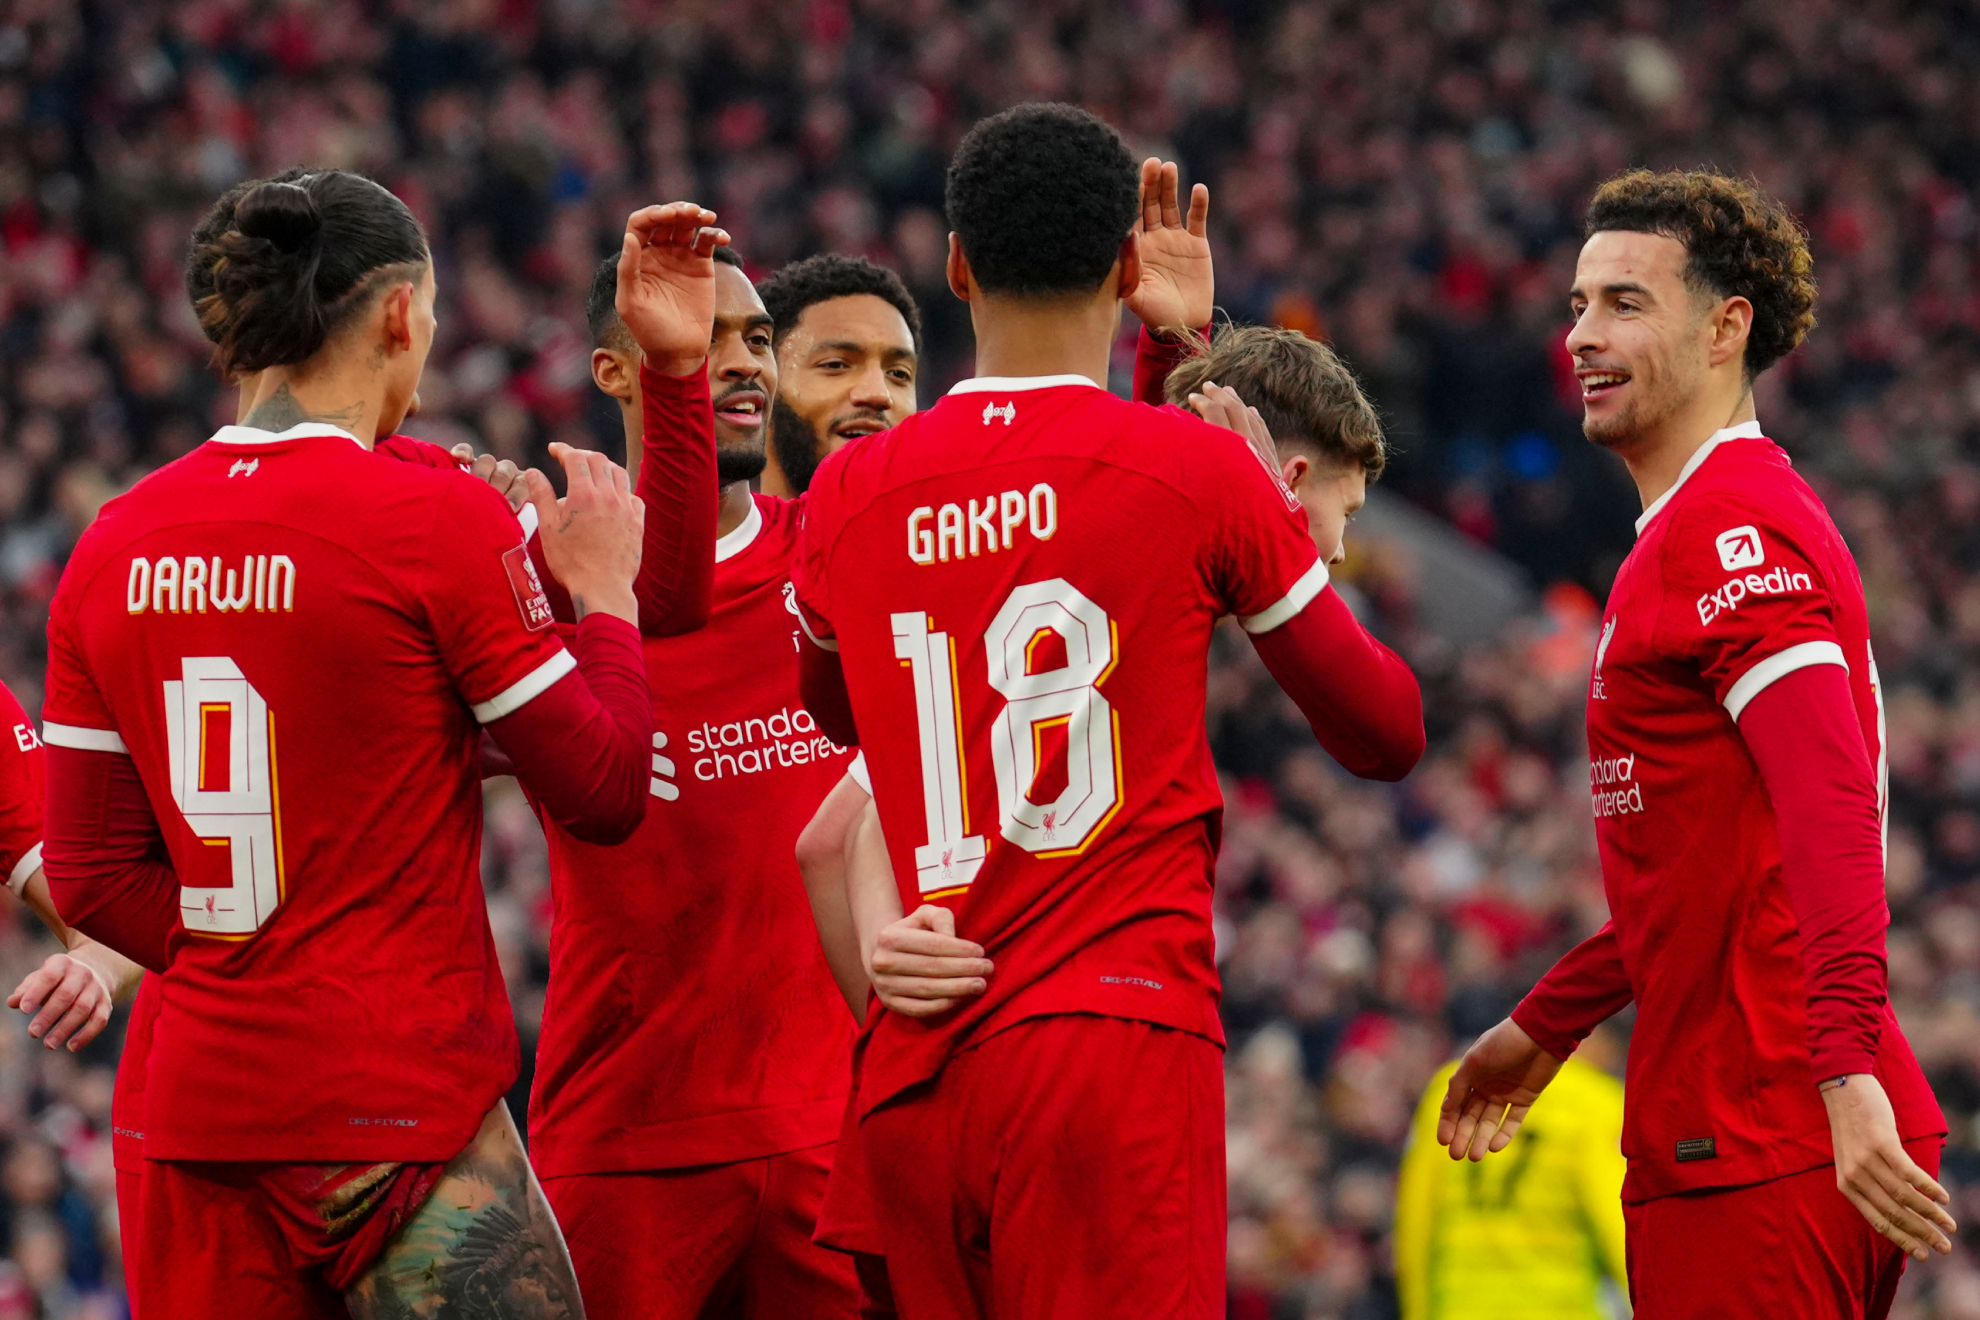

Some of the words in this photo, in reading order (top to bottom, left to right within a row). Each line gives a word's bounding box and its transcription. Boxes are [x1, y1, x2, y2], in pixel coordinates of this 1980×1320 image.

[907, 483, 1057, 565] GAKPO
[127, 555, 296, 614] DARWIN
[1697, 566, 1813, 627] Expedia
[687, 706, 822, 753] standa
[890, 577, 1123, 901] 18
[163, 656, 285, 941] 9
